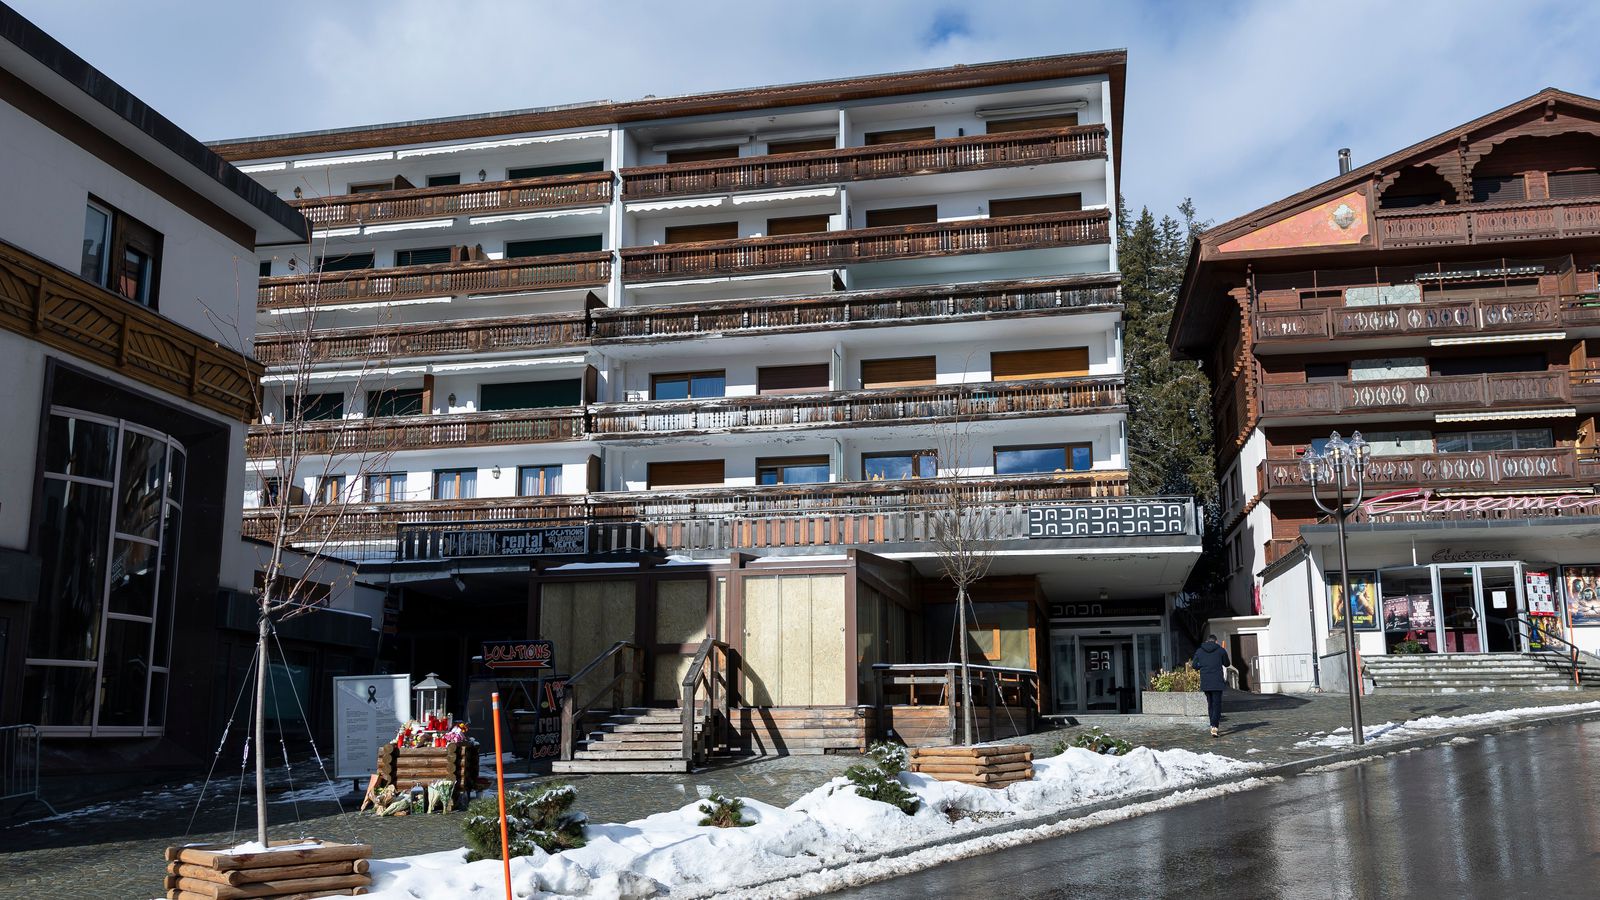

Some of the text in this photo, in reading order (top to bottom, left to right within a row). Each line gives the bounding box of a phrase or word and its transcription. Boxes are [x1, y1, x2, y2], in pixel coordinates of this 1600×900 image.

[502, 532, 542, 548] rental
[484, 644, 551, 660] LOCATIONS
[538, 716, 560, 733] ren
